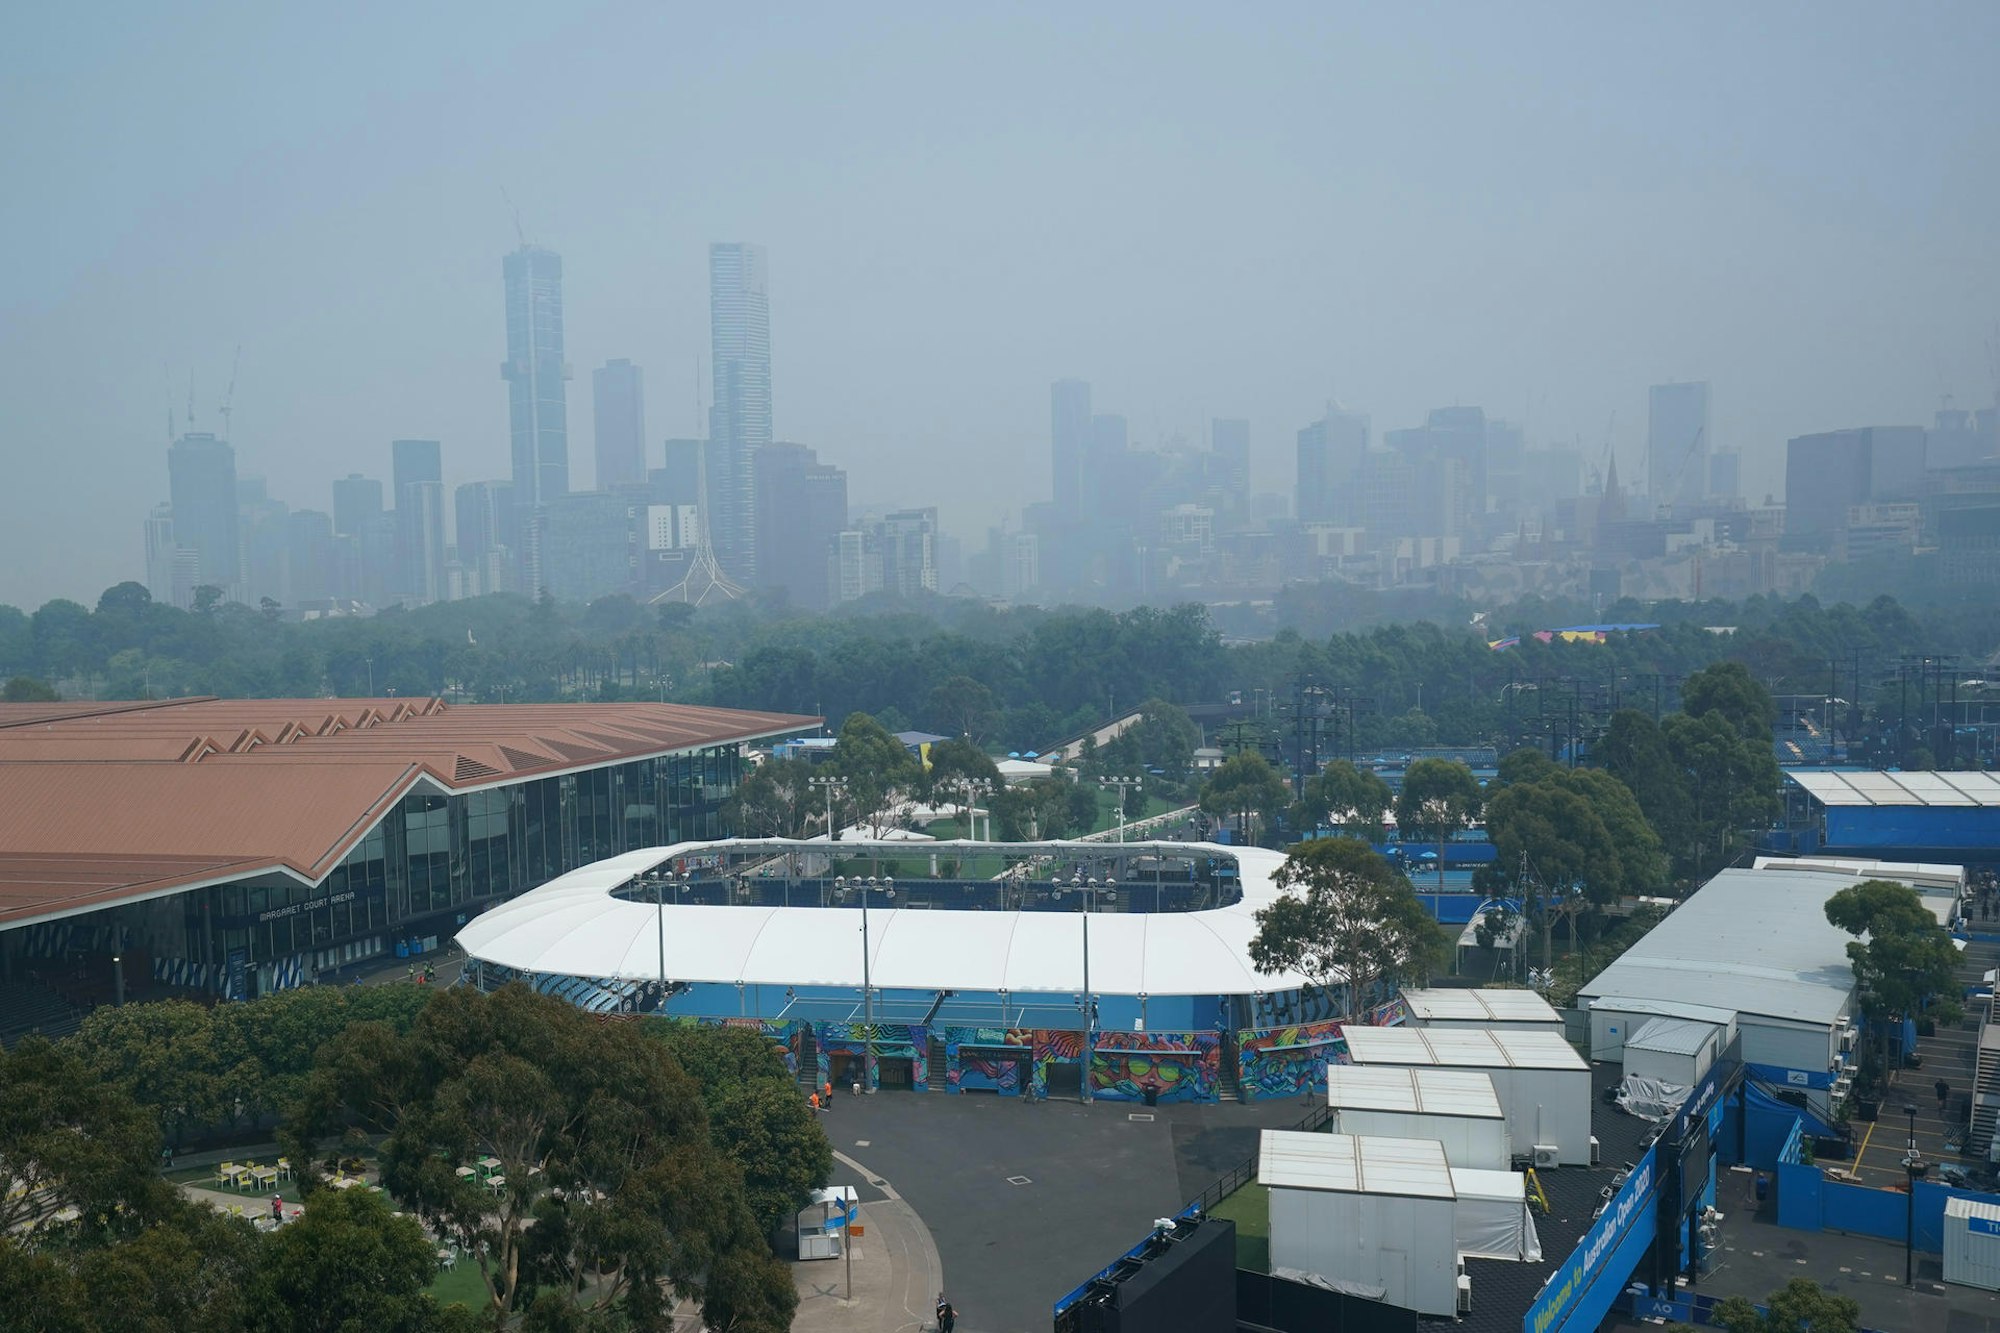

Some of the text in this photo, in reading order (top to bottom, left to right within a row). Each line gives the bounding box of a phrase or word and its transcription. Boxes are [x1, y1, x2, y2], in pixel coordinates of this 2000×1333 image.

[260, 891, 355, 922] MARGARET COURT ARENA
[1534, 1164, 1650, 1333] Welcome to Australian Open 2020
